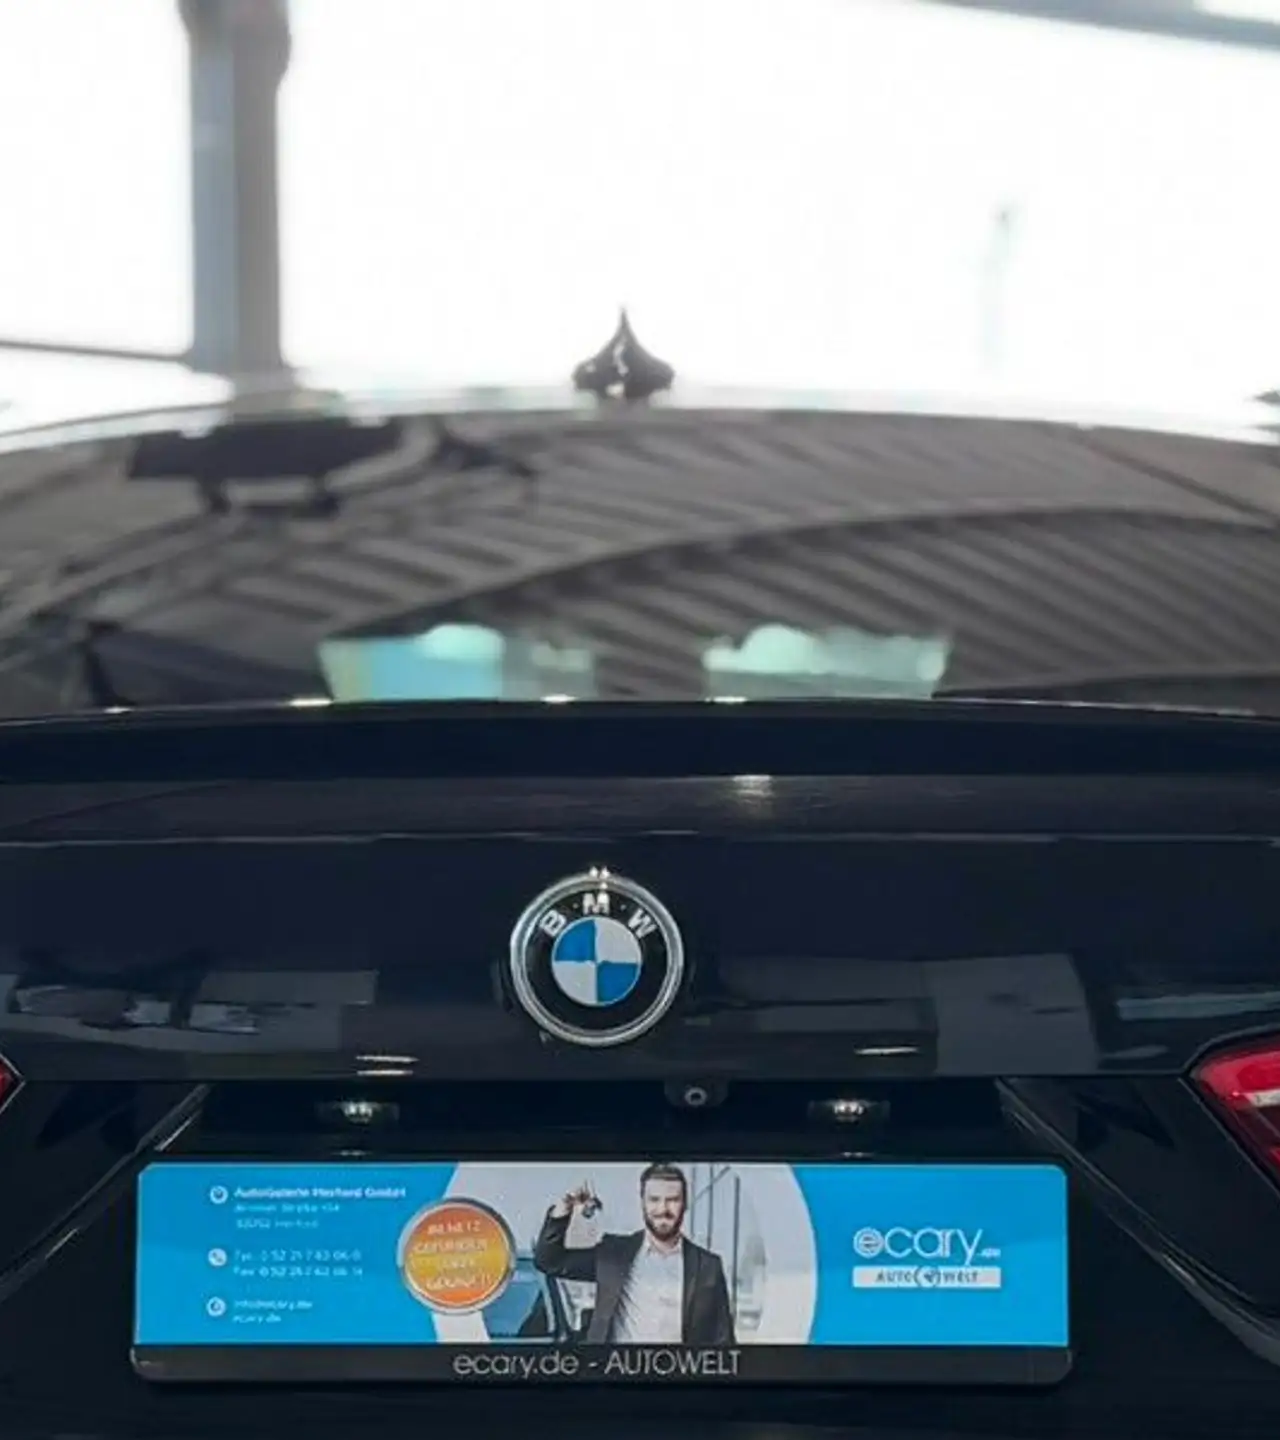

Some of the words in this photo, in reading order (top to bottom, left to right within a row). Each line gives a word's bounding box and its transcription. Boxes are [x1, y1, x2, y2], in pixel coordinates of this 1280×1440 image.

[539, 892, 658, 938] BMW
[453, 1350, 579, 1378] ecary.de
[604, 1350, 741, 1375] AUTOWELT
